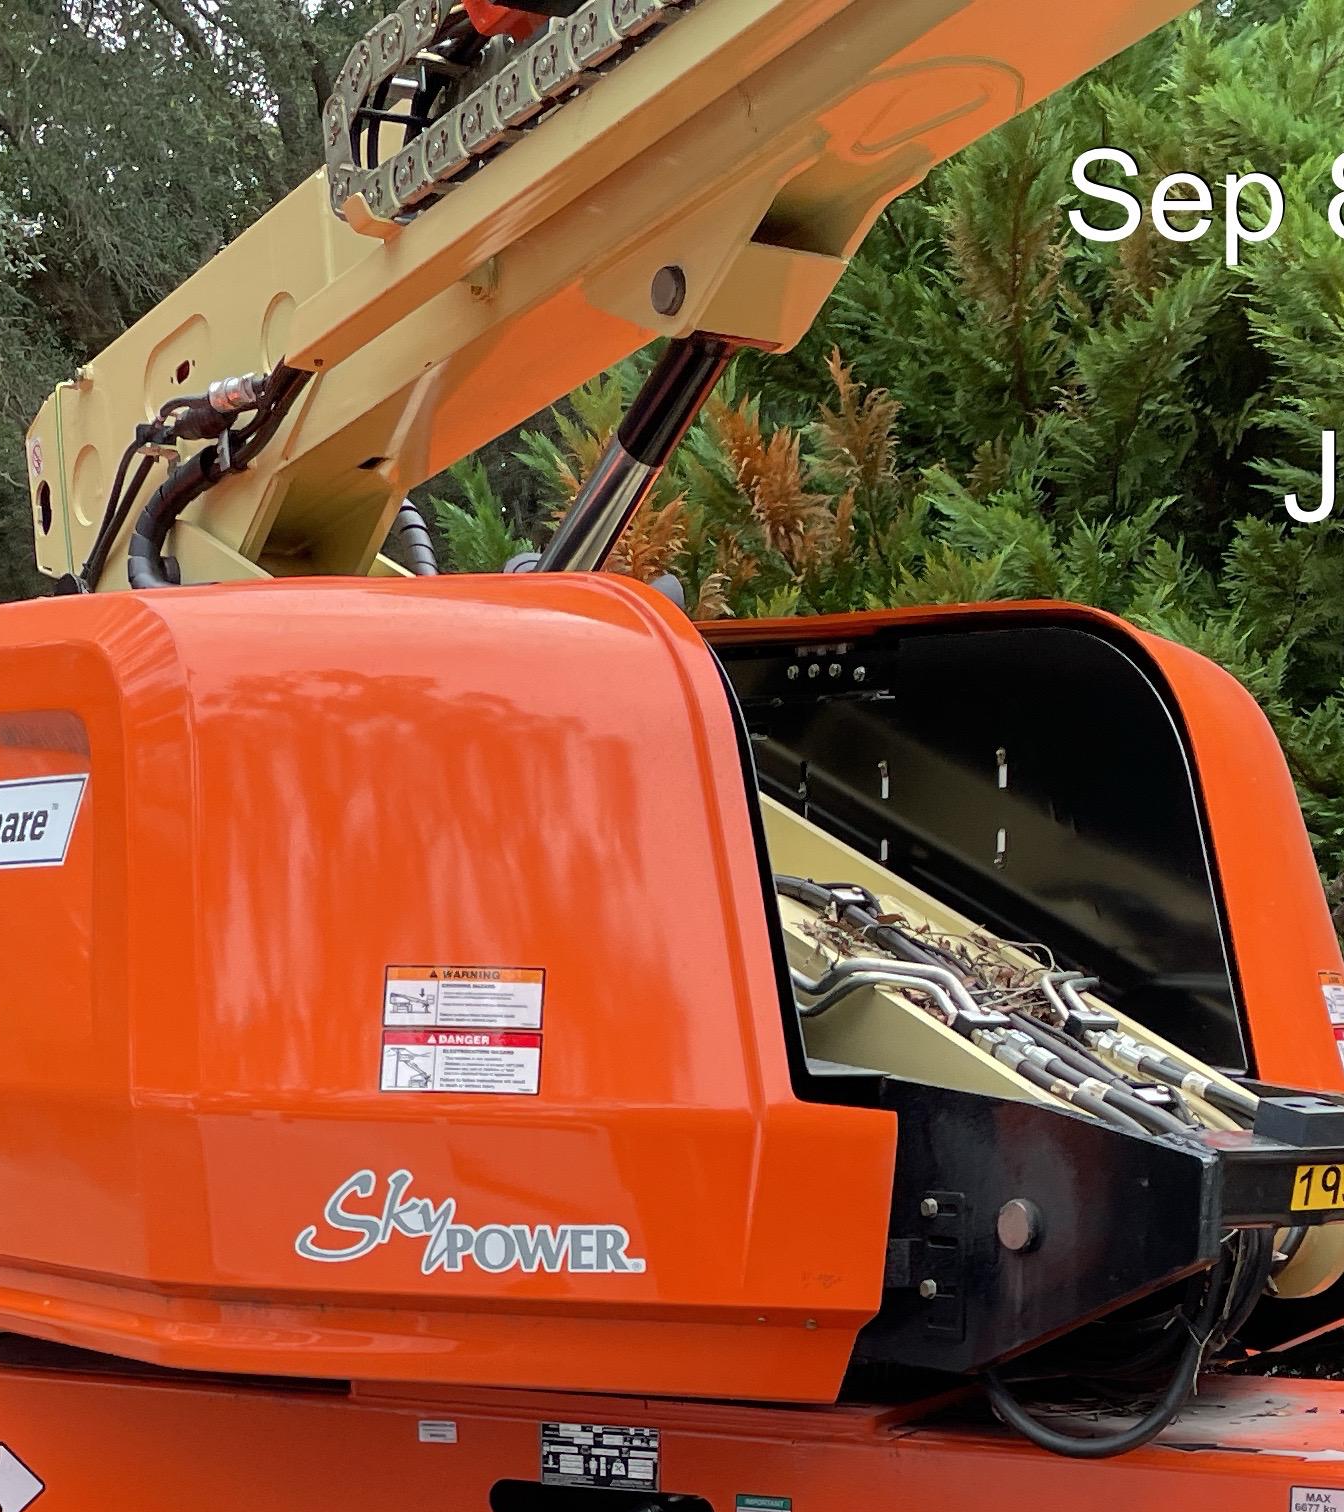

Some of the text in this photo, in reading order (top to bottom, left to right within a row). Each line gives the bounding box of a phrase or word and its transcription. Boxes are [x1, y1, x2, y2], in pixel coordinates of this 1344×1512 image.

[442, 970, 501, 980] WARNING
[438, 1034, 490, 1045] DANGER
[1305, 1493, 1331, 1503] MAX
[1294, 1502, 1320, 1512] 6677
